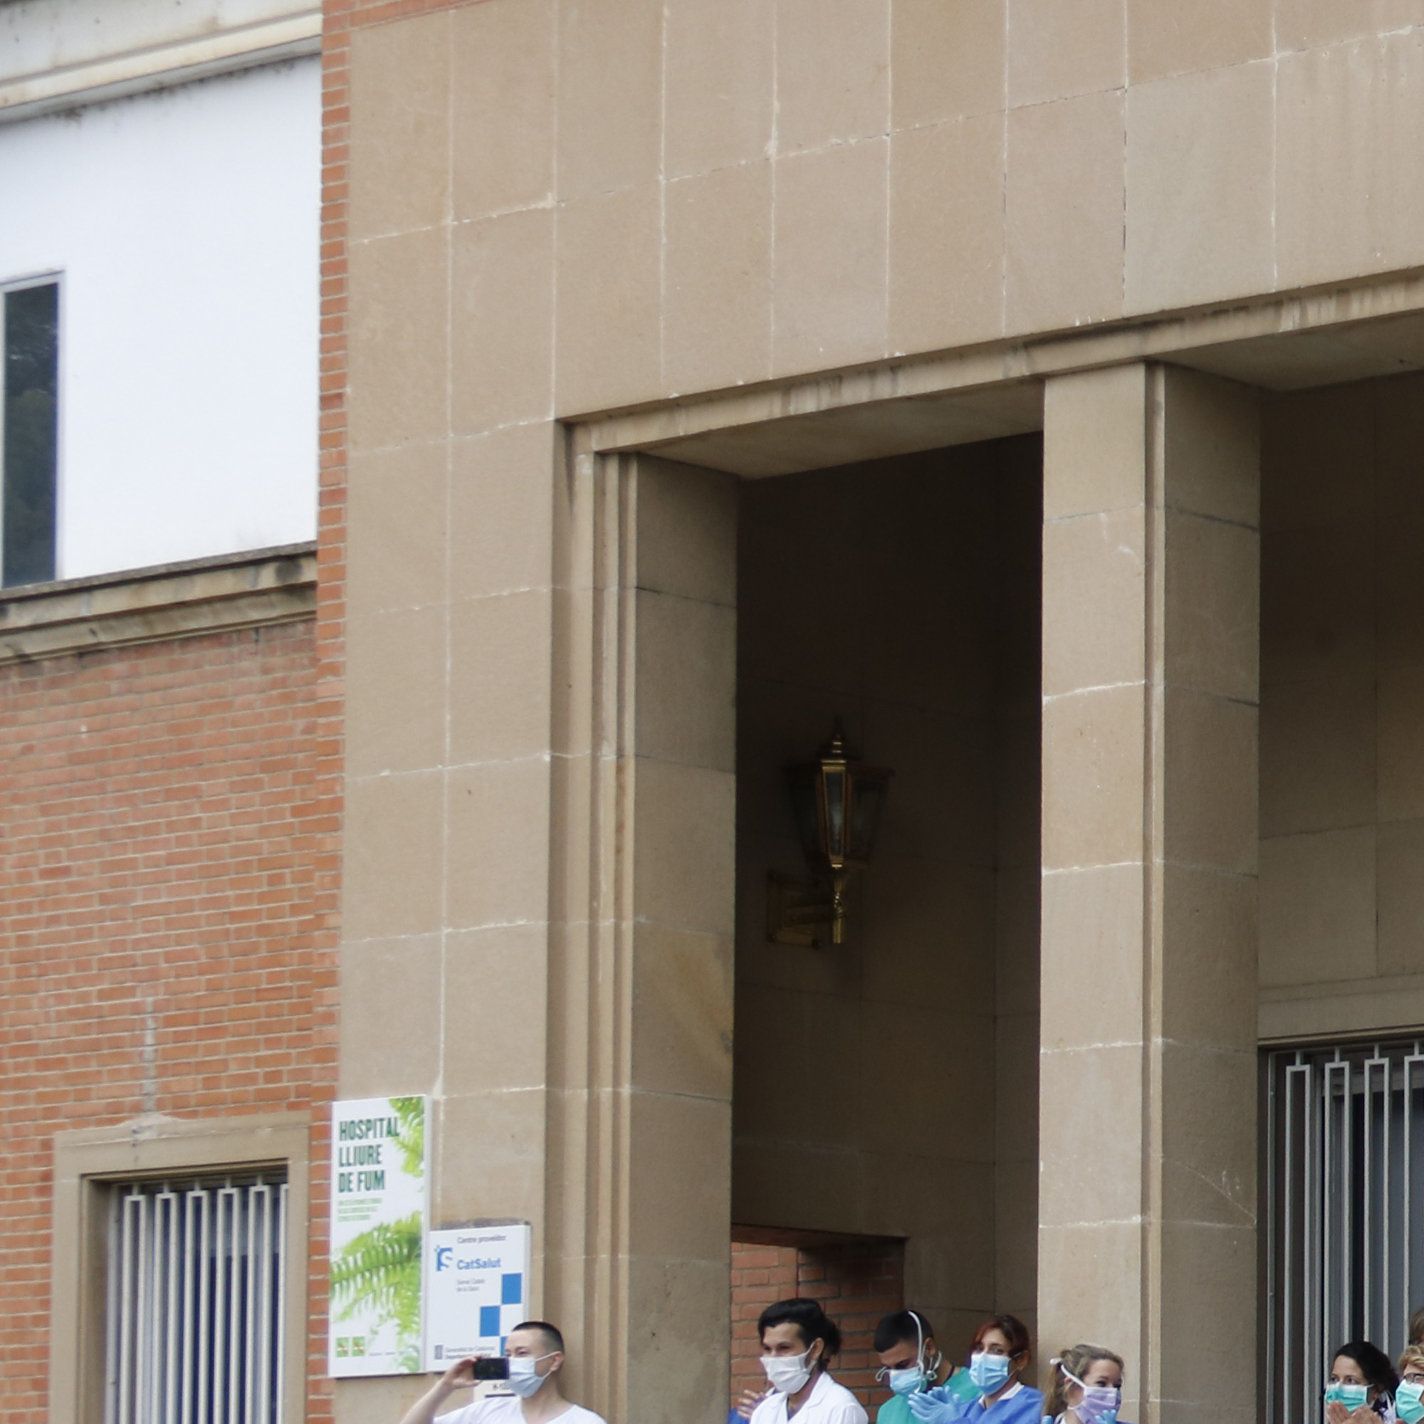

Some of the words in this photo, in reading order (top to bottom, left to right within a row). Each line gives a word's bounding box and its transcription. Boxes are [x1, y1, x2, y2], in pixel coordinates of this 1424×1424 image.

[339, 1117, 399, 1140] HOSPITAL
[339, 1144, 382, 1167] LLIURE
[339, 1172, 353, 1193] DE
[357, 1170, 385, 1192] FUM
[457, 1257, 501, 1270] CatSalut
